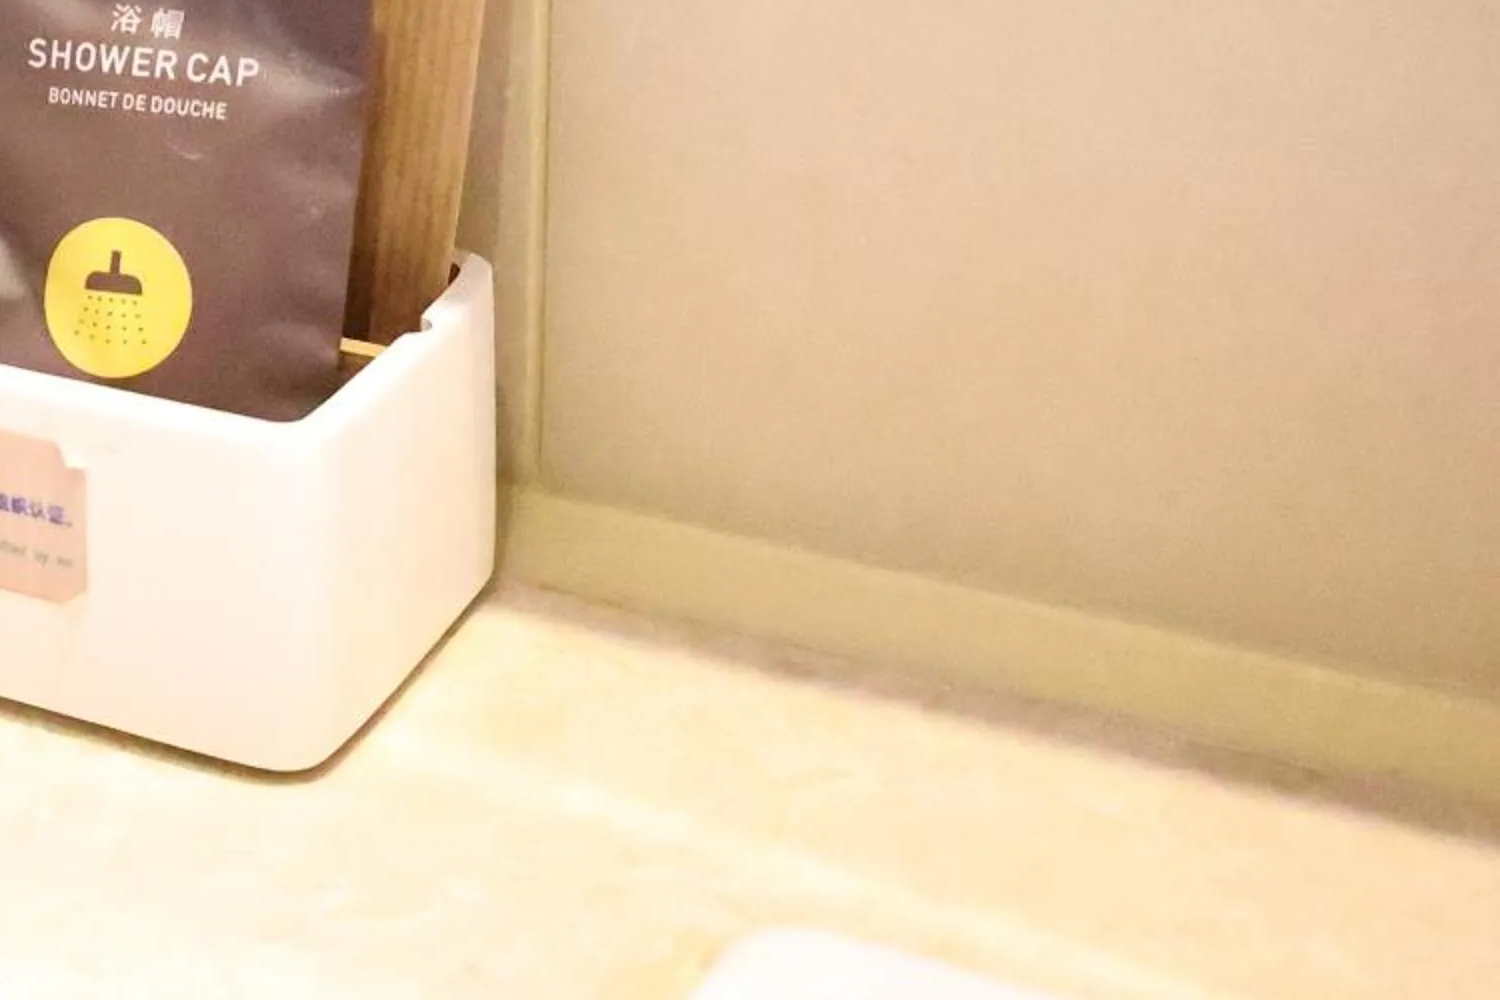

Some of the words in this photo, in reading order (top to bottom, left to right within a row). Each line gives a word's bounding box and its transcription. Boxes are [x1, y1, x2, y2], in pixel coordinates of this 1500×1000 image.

[110, 3, 186, 40] 浴帽
[27, 37, 179, 81] SHOWER
[186, 52, 260, 88] CAP
[48, 86, 119, 110] BONNET
[122, 92, 147, 112] DE
[150, 95, 229, 120] DOUCHE
